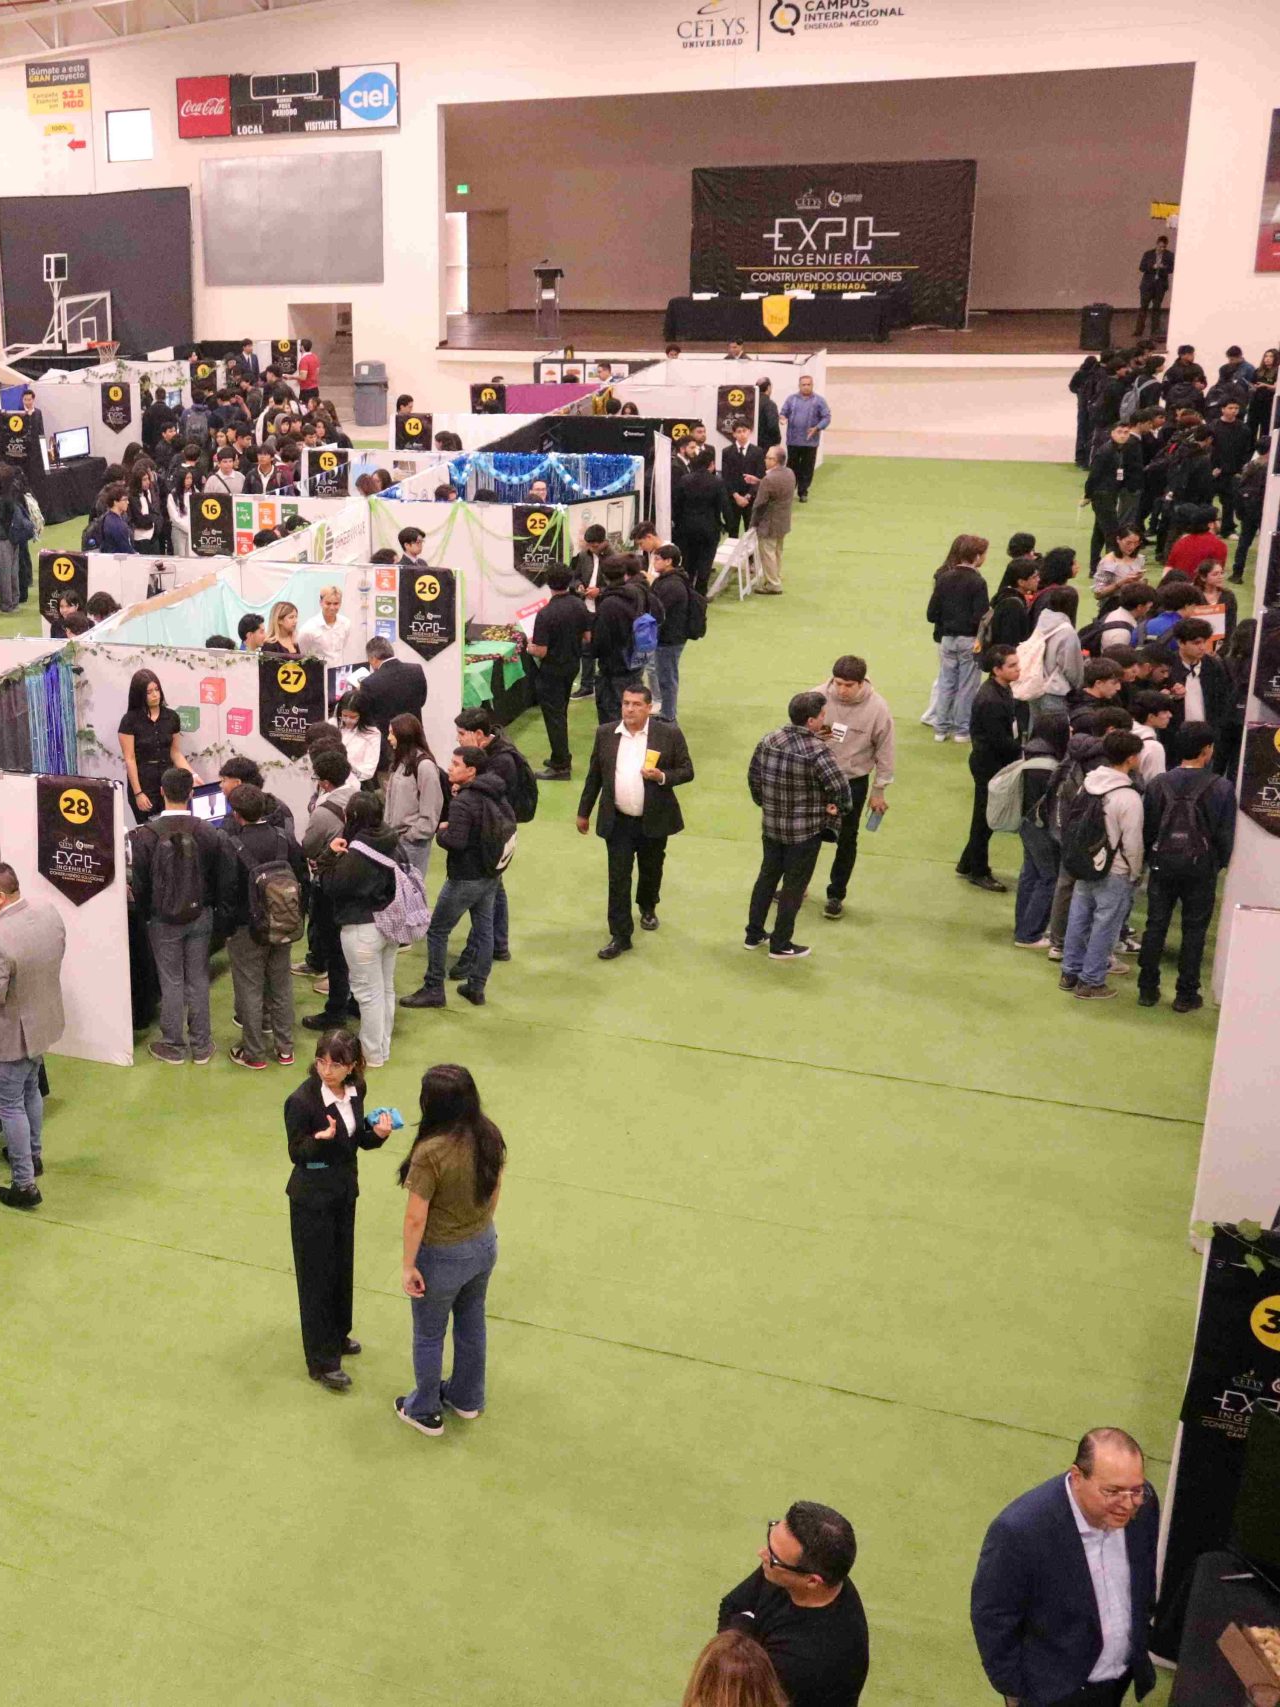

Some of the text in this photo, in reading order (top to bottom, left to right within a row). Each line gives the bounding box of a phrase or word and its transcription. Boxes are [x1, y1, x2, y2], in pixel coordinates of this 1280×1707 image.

[805, 0, 869, 11] CAMPUS
[804, 7, 904, 22] INTERNACIONAL
[677, 17, 746, 39] CETYS
[804, 21, 844, 30] ENSENADA
[682, 38, 743, 49] UNIVERSIDAD
[69, 64, 85, 73] este
[62, 89, 84, 99] $2.5
[349, 83, 390, 108] ciel
[63, 99, 84, 109] MDD
[237, 124, 264, 135] LOCAL
[305, 120, 337, 132] VISITANTE
[763, 217, 900, 250] EXPO
[773, 252, 871, 266] INGENIERÍA
[750, 271, 903, 283] CONSTRUYENDO SOLUCIONES
[783, 282, 867, 291] CAMPUS ENSENADA
[730, 394, 743, 402] 22
[408, 422, 419, 431] 14
[674, 428, 687, 437] 23
[322, 457, 334, 467] 15
[204, 504, 218, 515] 16
[529, 518, 547, 529] 25
[57, 563, 71, 575] 17
[417, 581, 438, 594] 26
[281, 670, 303, 685] 27
[63, 797, 89, 816] 28
[52, 851, 101, 868] EXPO
[1259, 1308, 1280, 1334] 3
[1201, 1419, 1249, 1434] CONSTRUYE
